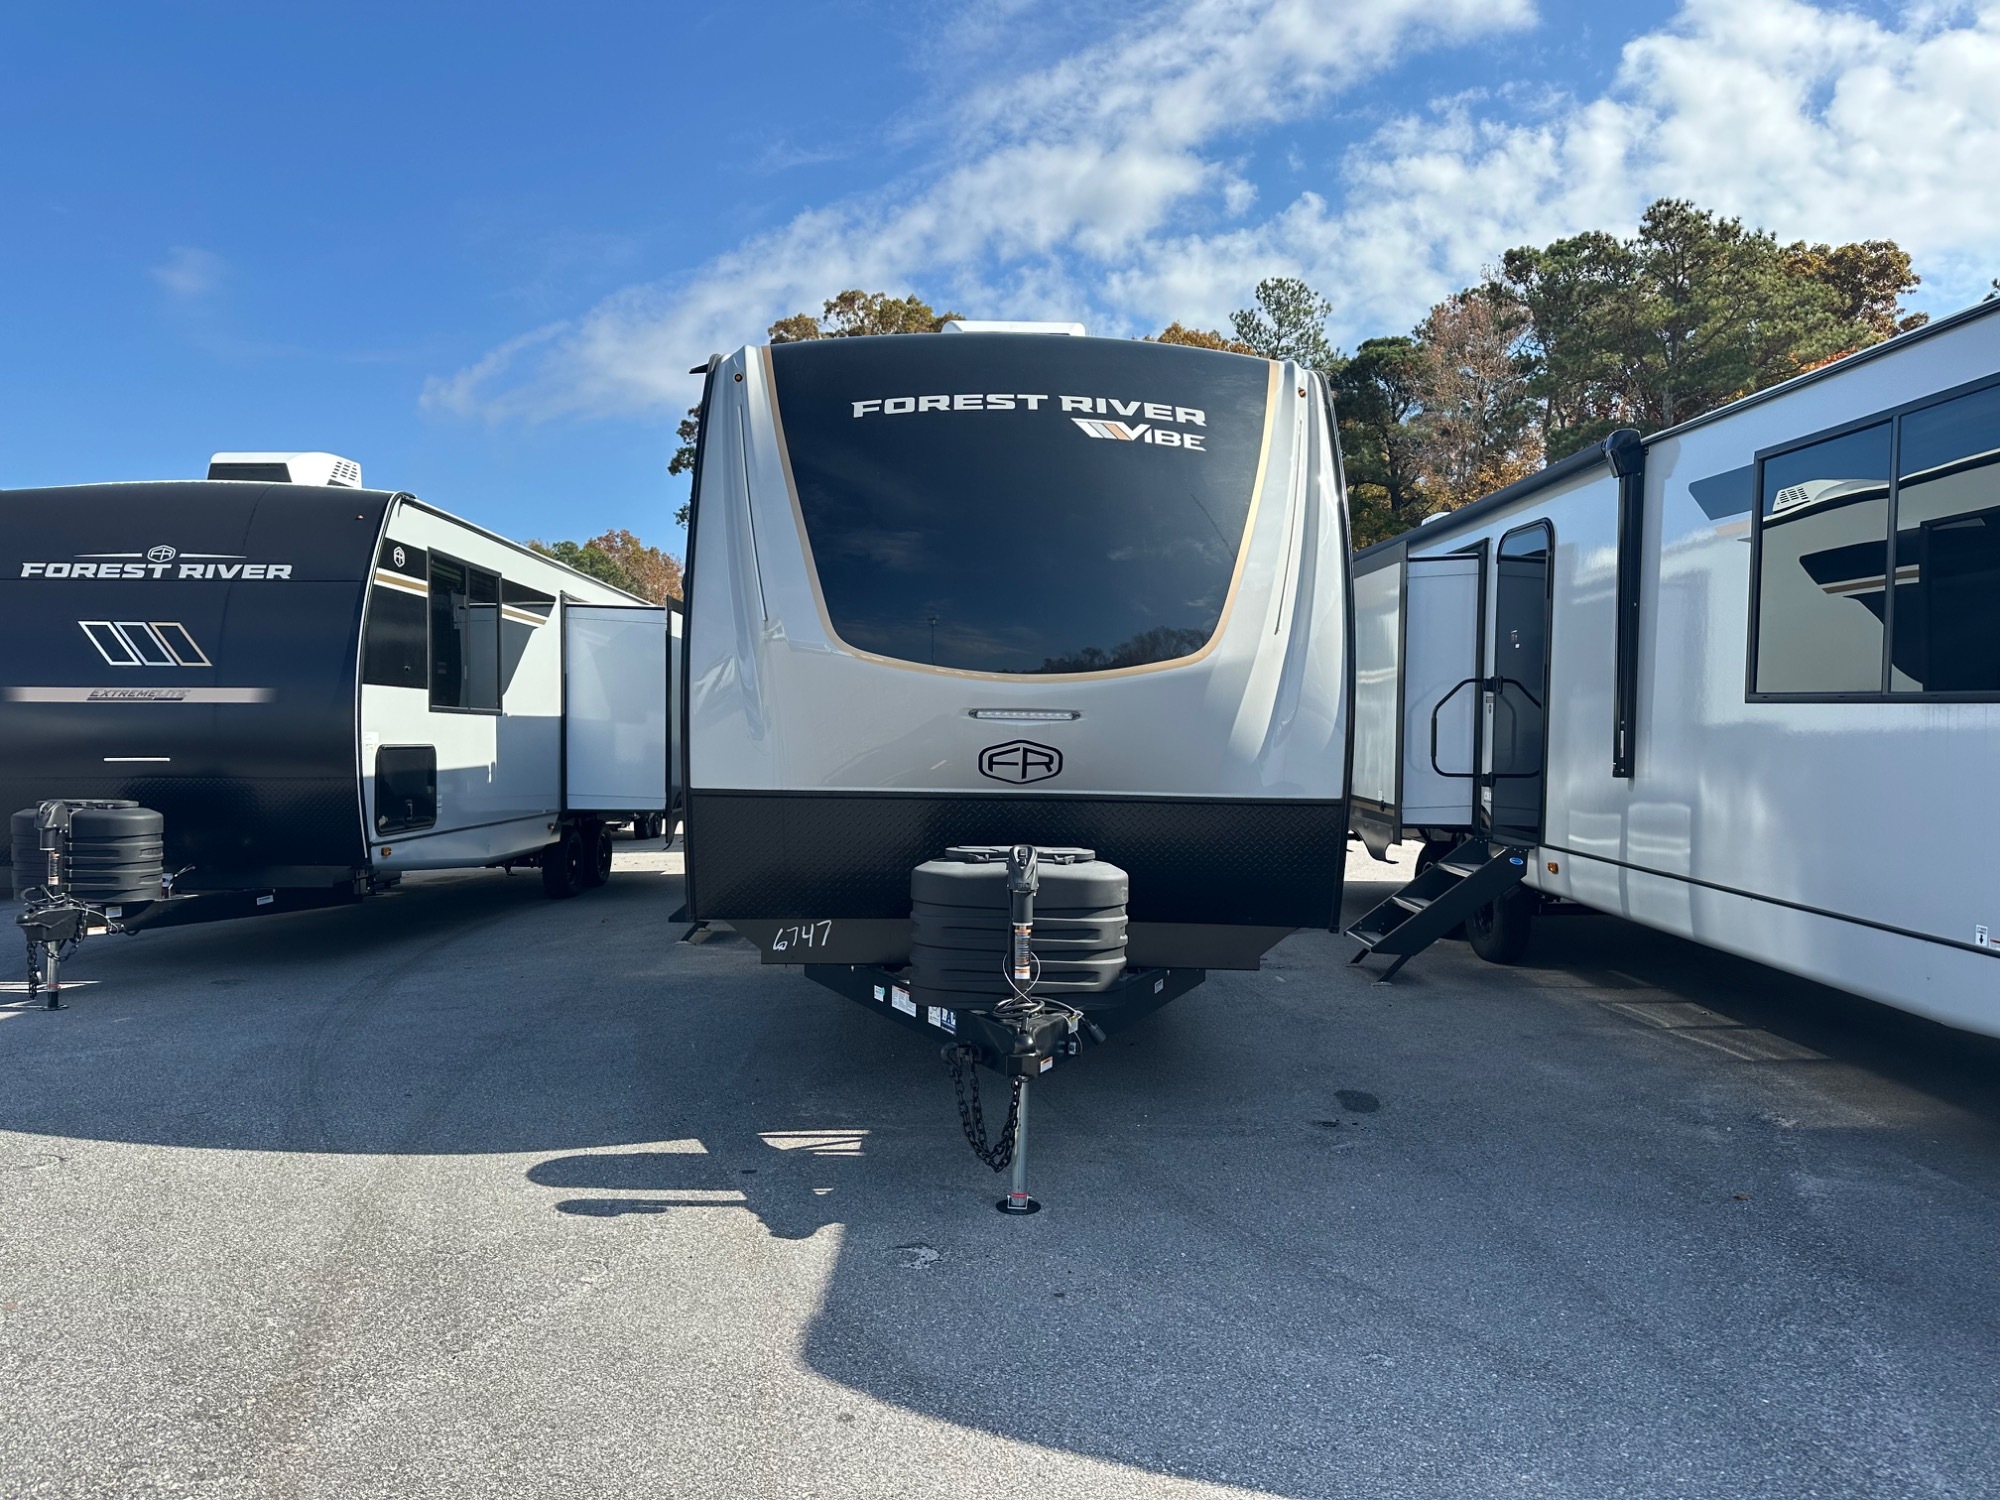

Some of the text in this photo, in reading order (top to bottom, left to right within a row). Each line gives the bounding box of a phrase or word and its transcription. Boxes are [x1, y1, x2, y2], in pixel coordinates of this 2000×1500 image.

[851, 393, 1207, 427] FOREST RIVER
[1108, 420, 1207, 451] VIBE
[21, 562, 293, 579] FOREST RIVER
[772, 919, 832, 951] 6747
